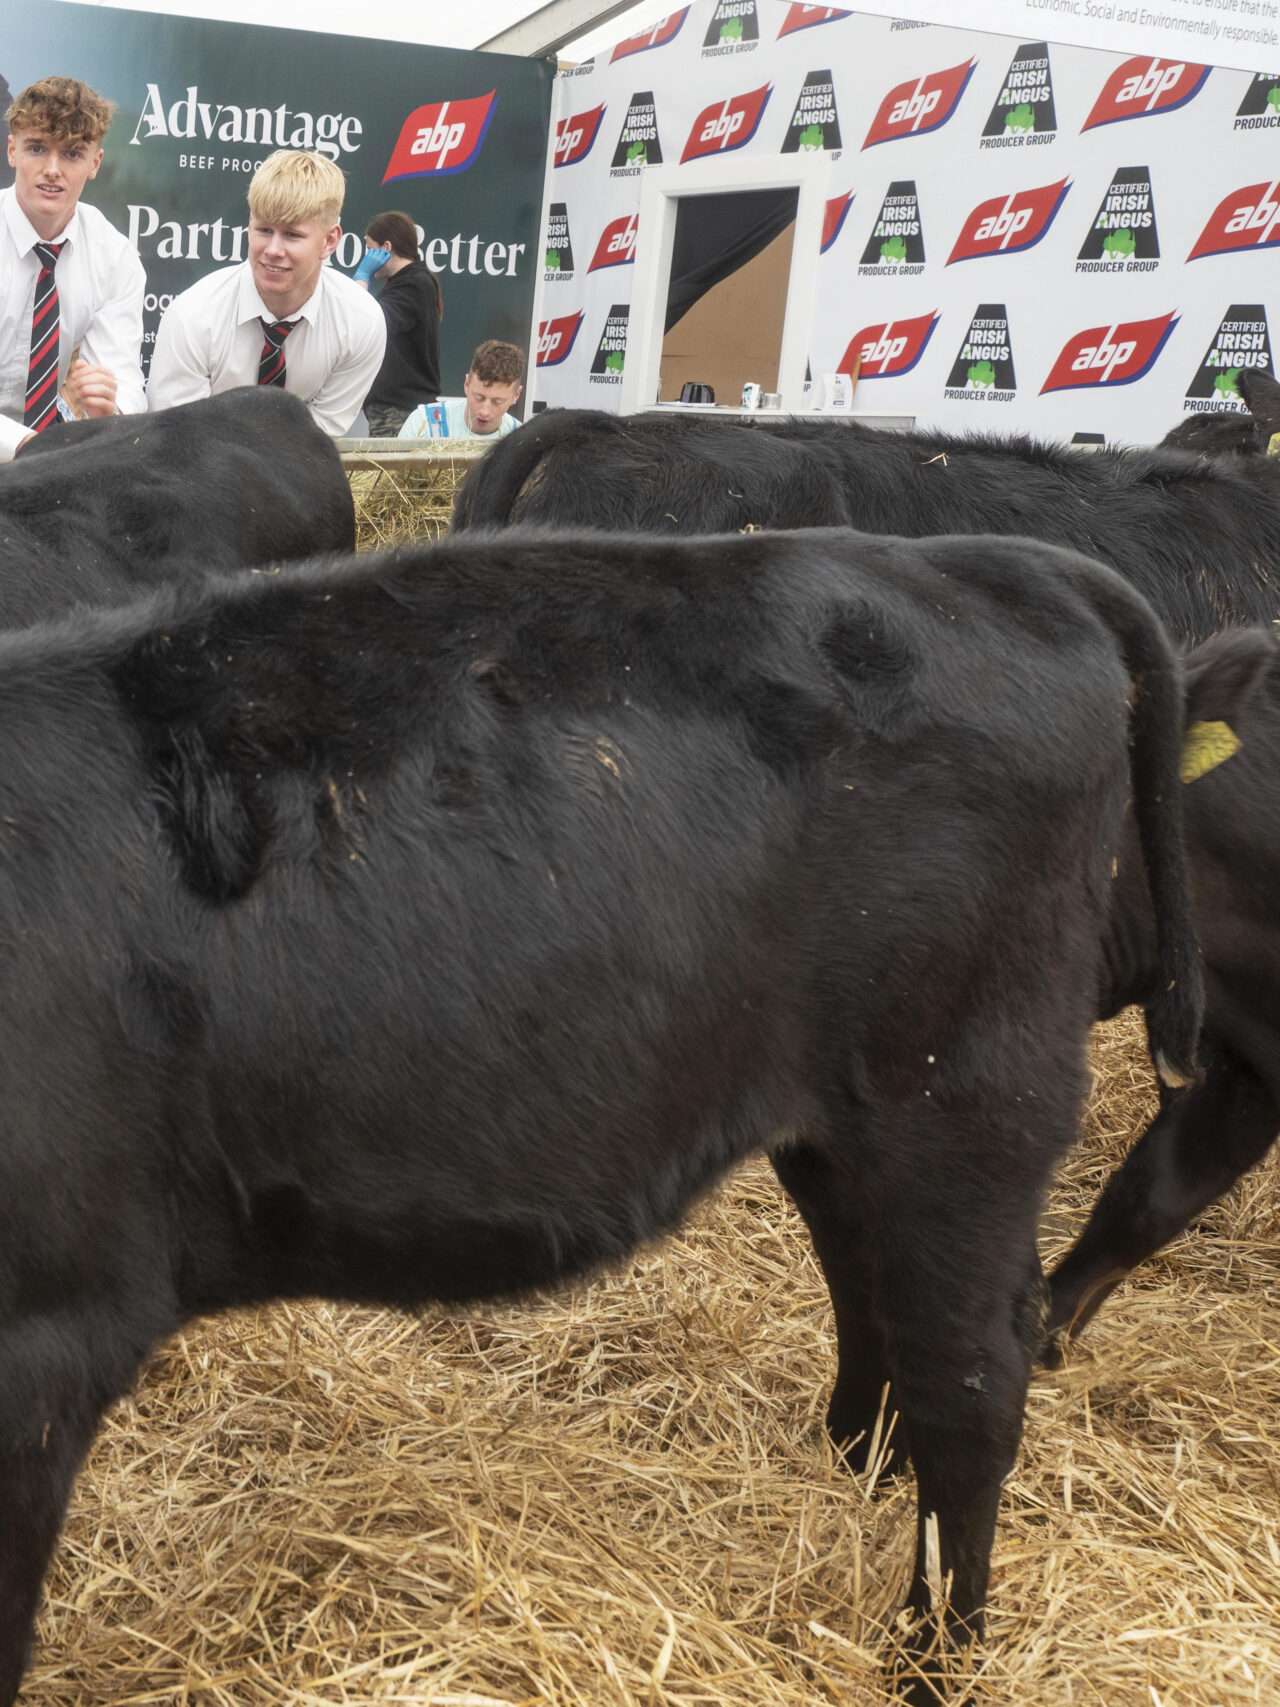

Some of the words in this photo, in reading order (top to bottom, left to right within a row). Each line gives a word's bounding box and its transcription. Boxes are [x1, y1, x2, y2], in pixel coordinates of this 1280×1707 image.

[715, 1, 755, 20] ANGUS
[1240, 1, 1260, 15] that
[1262, 2, 1278, 18] the
[1084, 0, 1116, 20] Social
[1117, 7, 1138, 23] and
[1139, 9, 1221, 40] Environmentally
[701, 44, 734, 58] PRODUCER
[735, 42, 758, 53] GROUP
[574, 65, 595, 76] GROUP
[1011, 58, 1048, 71] CERTIFIED
[1008, 69, 1047, 88] IRISH
[1115, 58, 1185, 111] abp
[801, 83, 833, 96] CERTIFIED
[998, 86, 1050, 105] ANGUS
[628, 104, 654, 115] CERTIFIED
[800, 94, 833, 110] IRISH
[888, 77, 942, 132] abp
[129, 83, 363, 162] Advantage
[627, 114, 653, 127] IRISH
[700, 98, 745, 149] abp
[792, 108, 836, 127] ANGUS
[410, 101, 466, 170] abp
[621, 127, 657, 142] ANGUS
[980, 135, 1024, 149] PRODUCER
[1026, 133, 1056, 146] GROUP
[179, 154, 214, 170] BEEF
[222, 158, 263, 173] PROG
[609, 167, 641, 178] PRODUCER
[1109, 182, 1150, 194] CERTIFIED
[884, 195, 916, 206] CERTIFIED
[1105, 194, 1149, 211] IRISH
[882, 205, 916, 221] IRISH
[974, 192, 1033, 250] abp
[1095, 211, 1153, 230] ANGUS
[127, 204, 249, 262] Partn
[547, 223, 566, 236] RISH
[874, 221, 919, 237] ANGUS
[546, 236, 569, 249] NGUS
[858, 266, 897, 276] PRODUCER
[899, 265, 925, 276] GROUP
[1075, 262, 1124, 273] PRODUCER
[1126, 261, 1159, 272] GROUP
[555, 272, 574, 282] GROUP
[605, 325, 628, 338] IRIS
[972, 319, 1006, 329] CERTIFIED
[1221, 321, 1265, 332] CERTIFIED
[536, 320, 562, 363] bp
[600, 337, 627, 351] ANGU
[969, 329, 1006, 345] IRISH
[1217, 333, 1264, 350] IRISH
[860, 320, 908, 374] abp
[960, 344, 1009, 361] ANGUS
[1071, 324, 1137, 382] abp
[1205, 349, 1269, 368] ANGUS
[589, 375, 619, 384] PRODUCER
[944, 389, 985, 401] PRODUCER
[987, 391, 1016, 402] GROUP
[1184, 400, 1238, 413] PRODUCER
